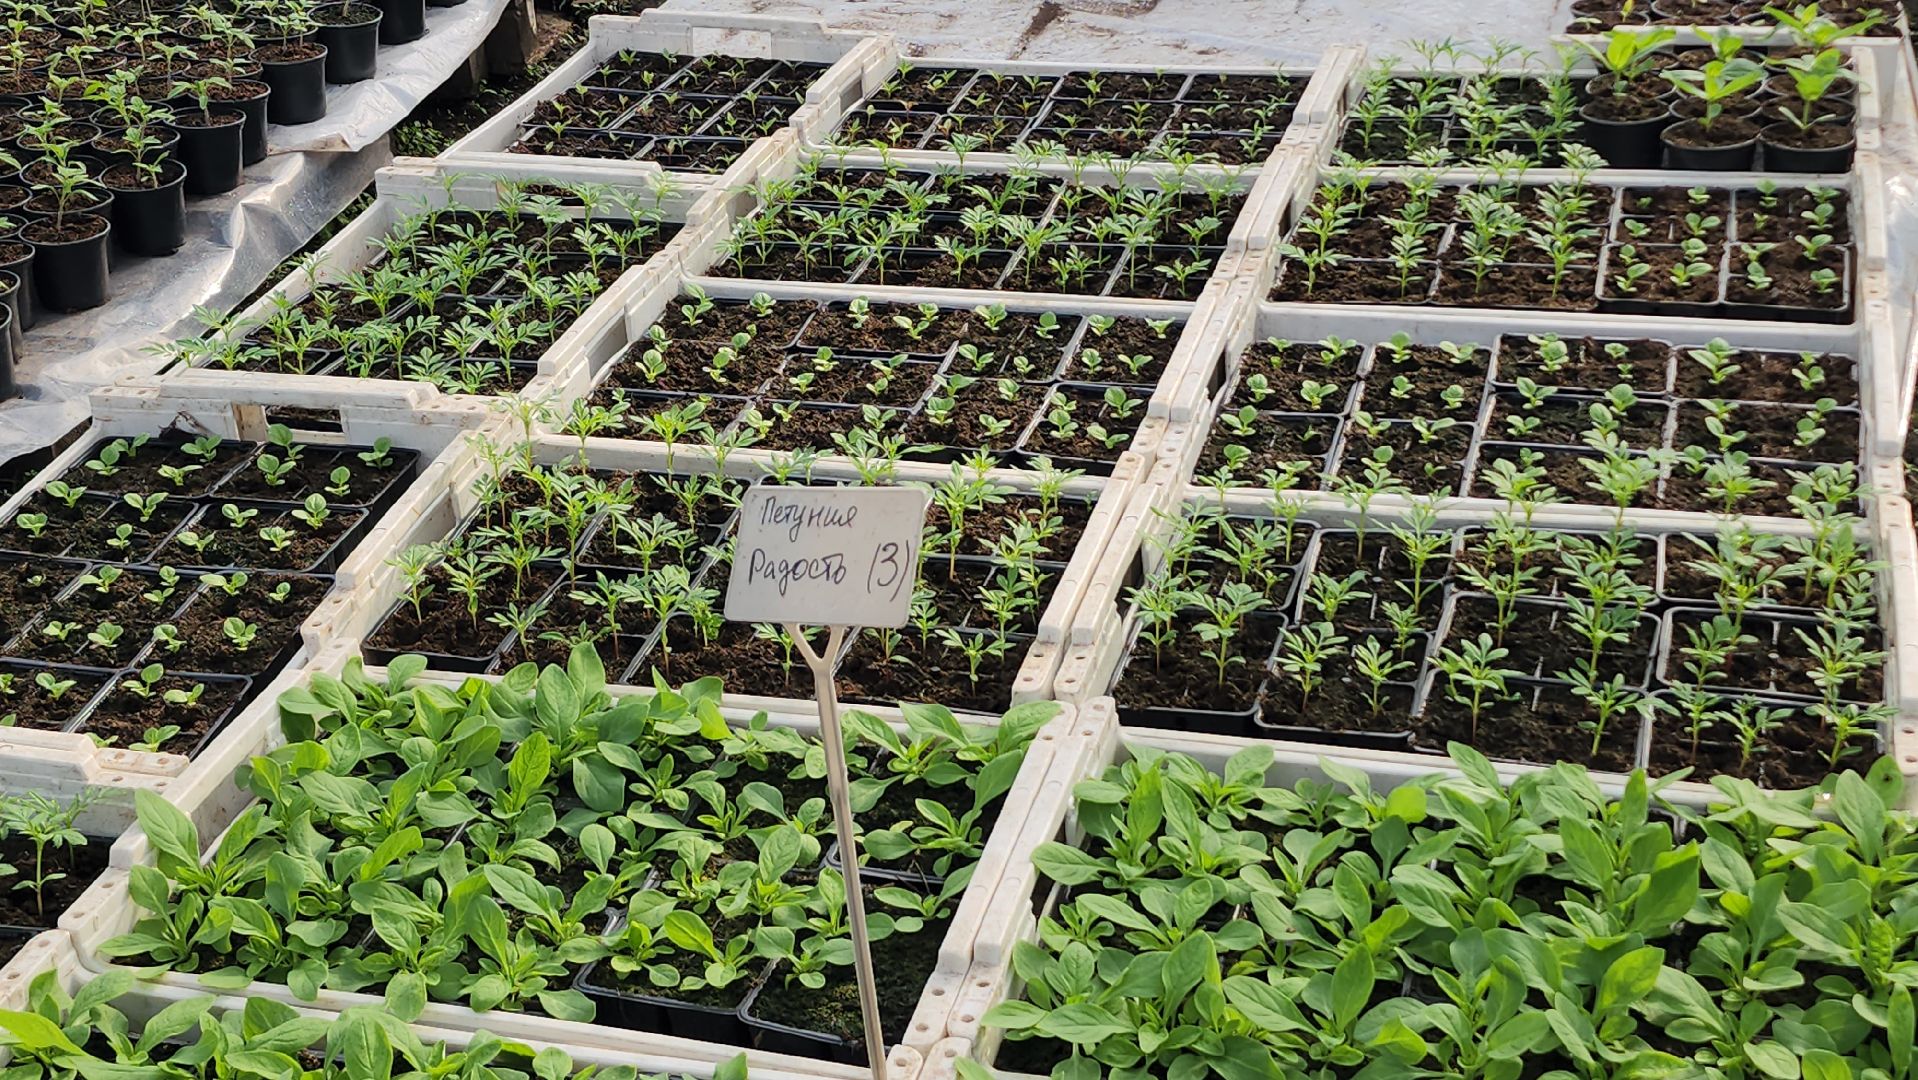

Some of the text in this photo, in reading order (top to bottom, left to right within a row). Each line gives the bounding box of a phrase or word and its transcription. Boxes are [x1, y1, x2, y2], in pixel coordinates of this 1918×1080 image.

[761, 495, 857, 542] Петуния
[749, 540, 910, 601] Радость (3)
